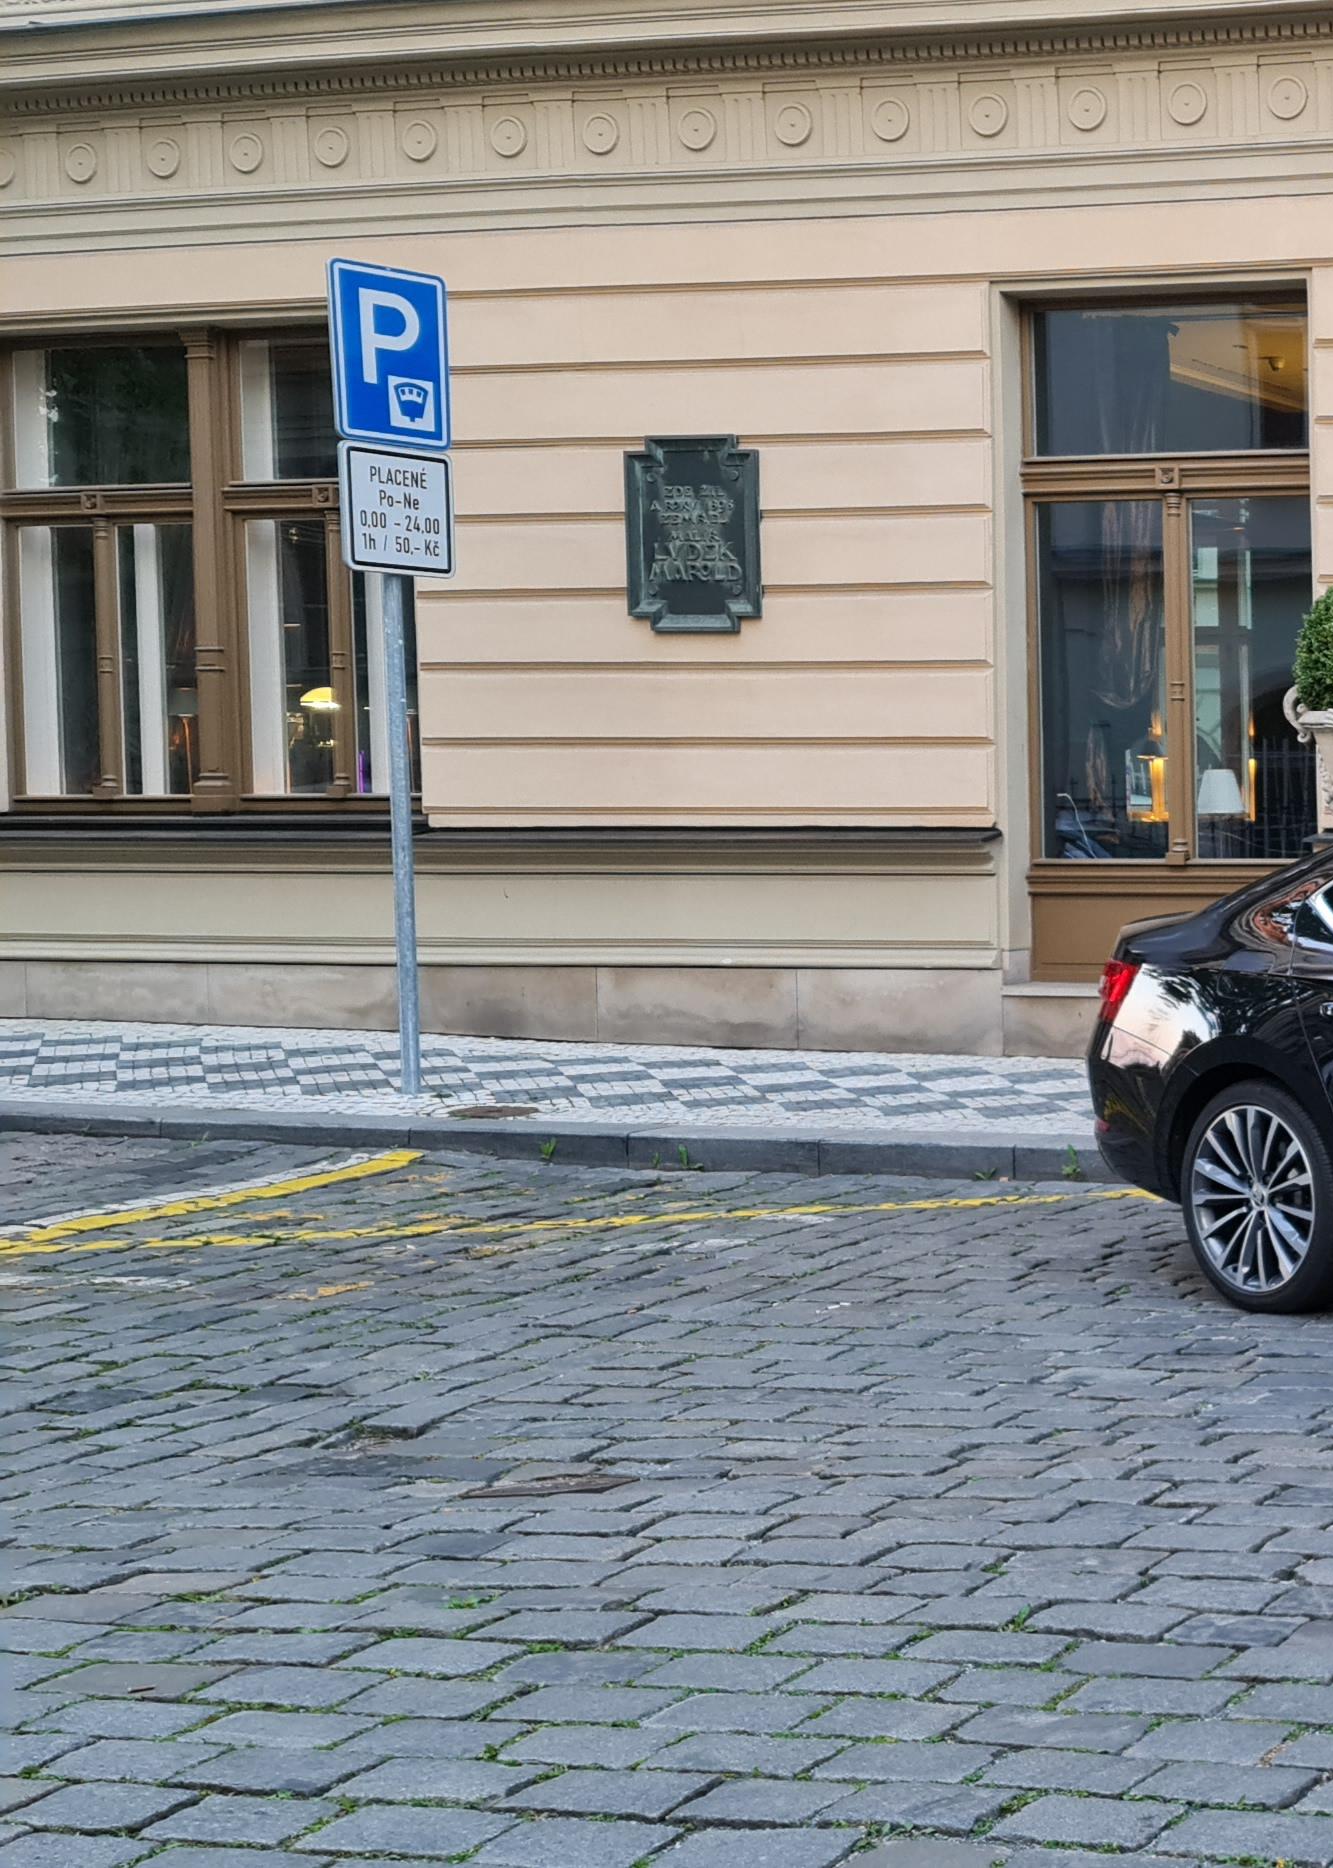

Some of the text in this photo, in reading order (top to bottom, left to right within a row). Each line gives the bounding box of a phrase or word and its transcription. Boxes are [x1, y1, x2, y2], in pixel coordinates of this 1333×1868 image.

[358, 287, 420, 384] P
[369, 466, 428, 489] PLACENÉ
[379, 489, 420, 510] Po-Ne
[362, 532, 376, 550] 1h
[424, 539, 440, 557] Kč
